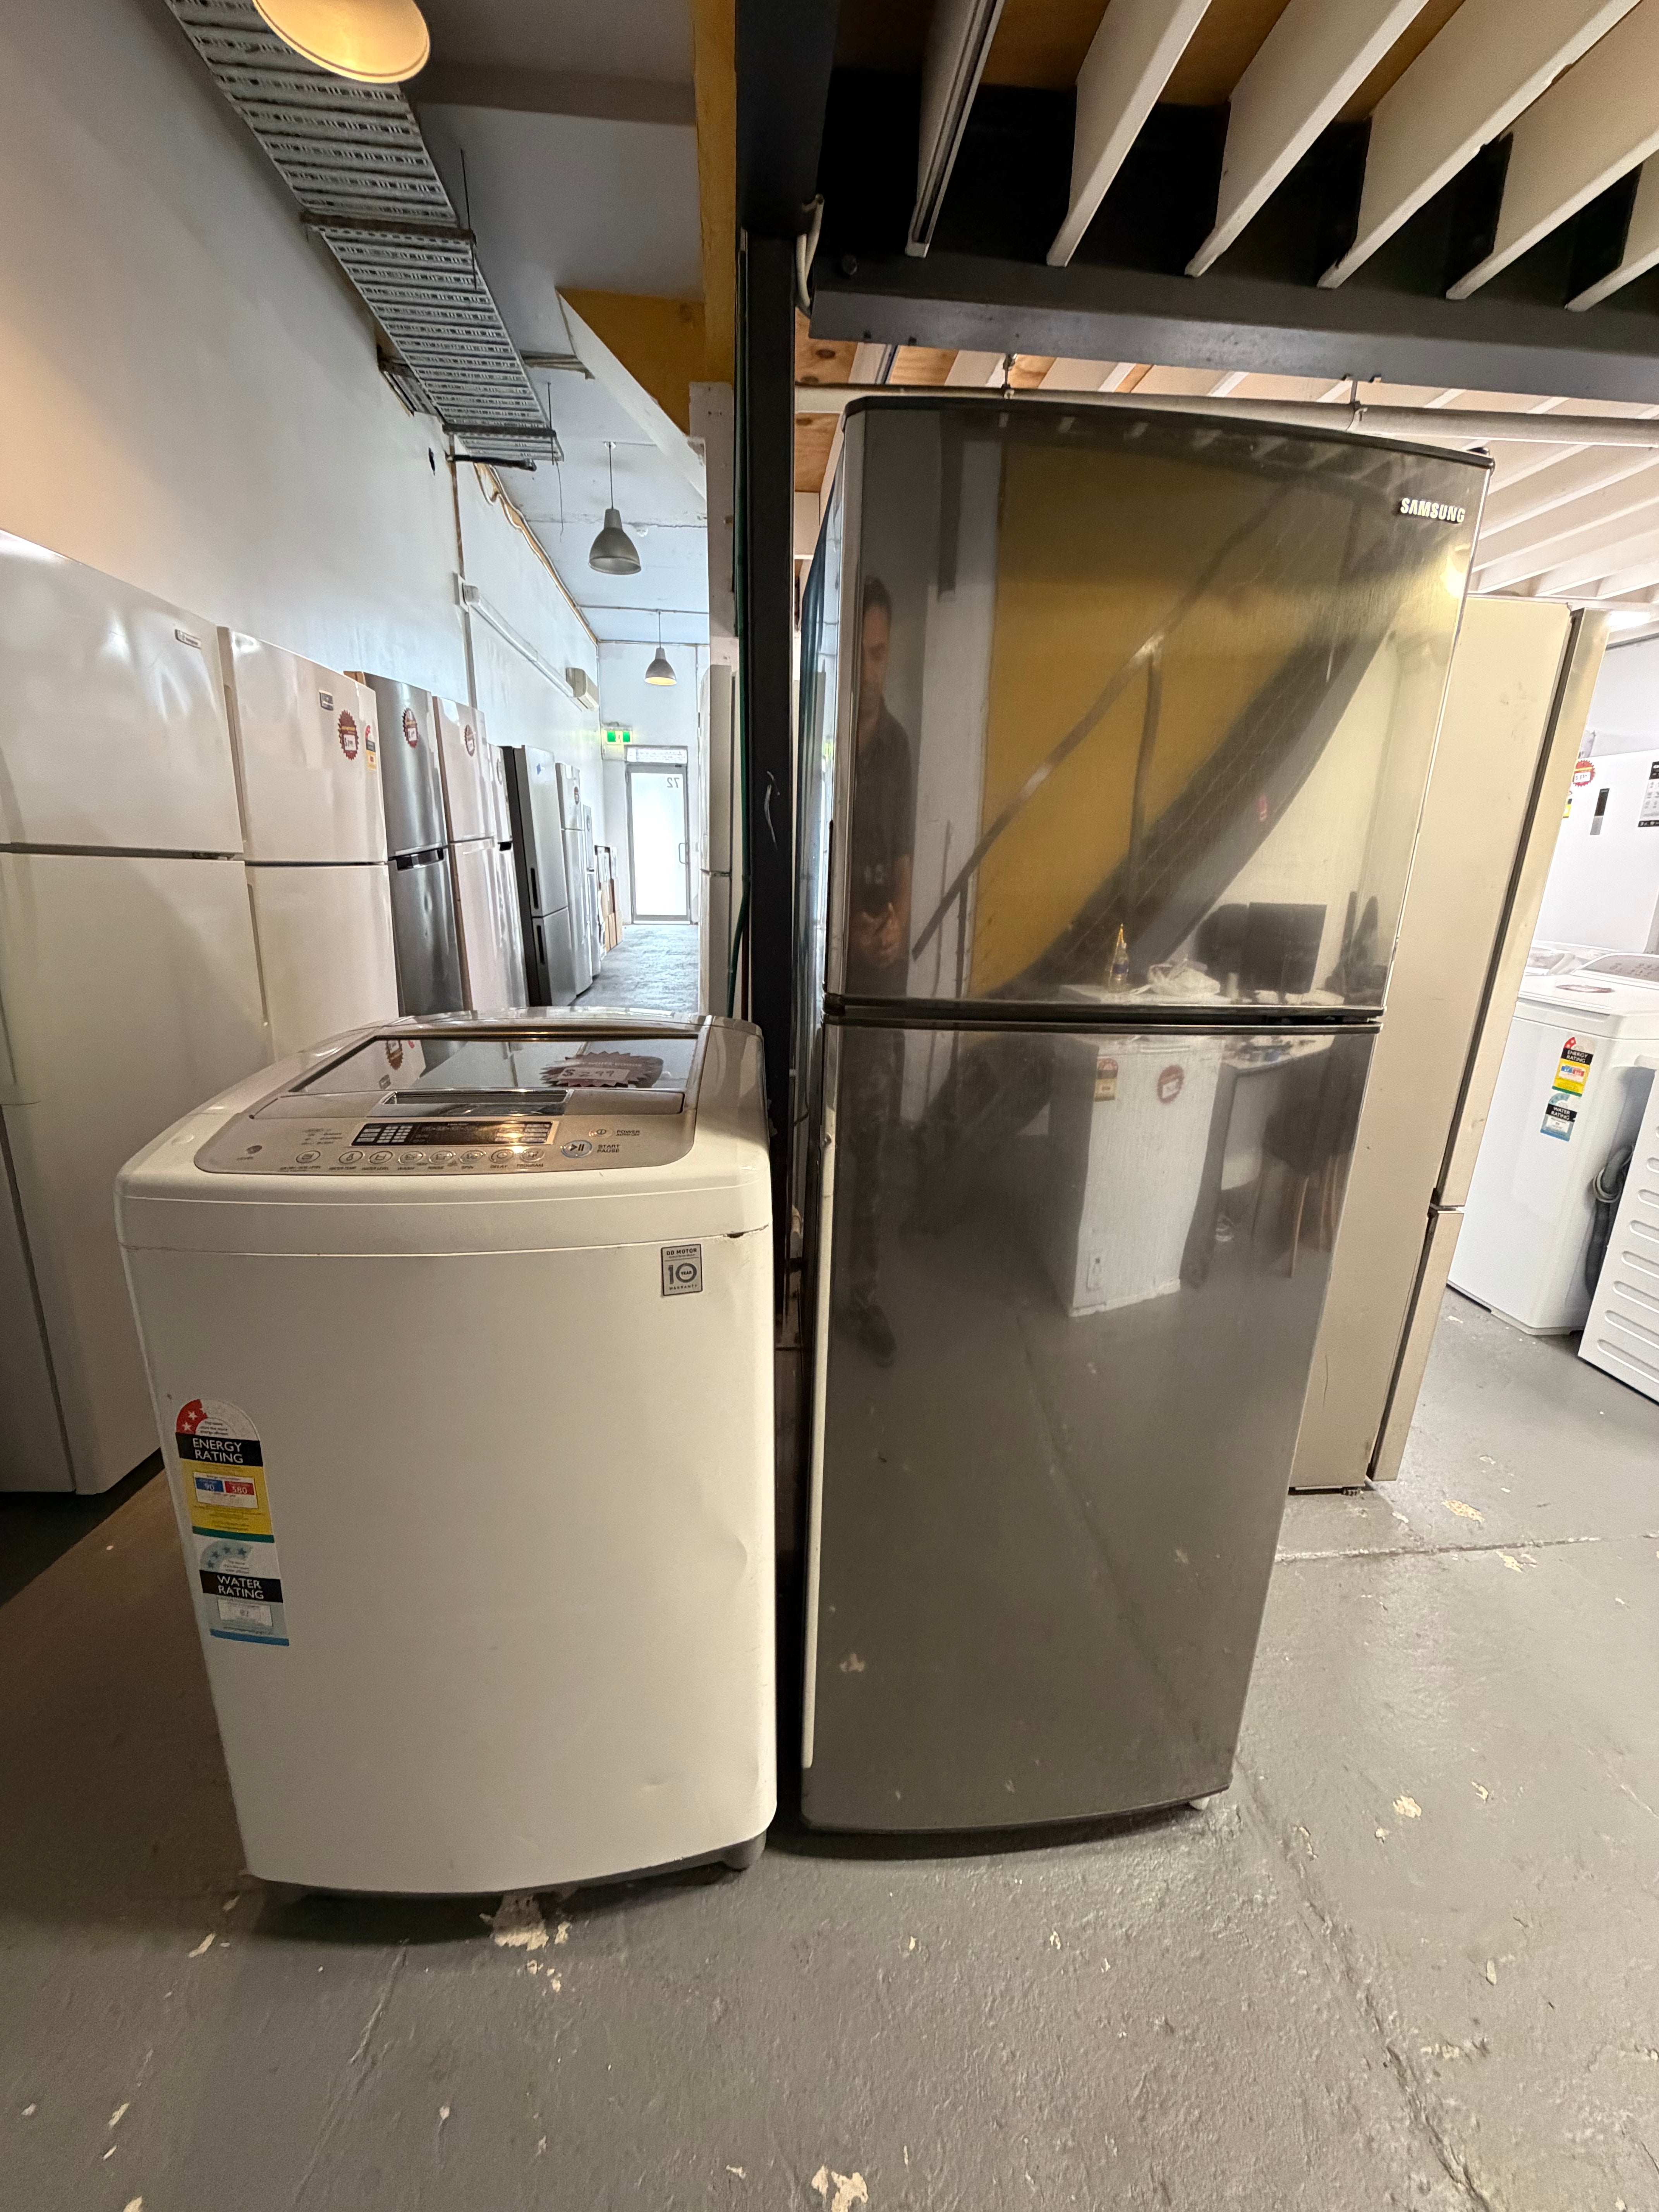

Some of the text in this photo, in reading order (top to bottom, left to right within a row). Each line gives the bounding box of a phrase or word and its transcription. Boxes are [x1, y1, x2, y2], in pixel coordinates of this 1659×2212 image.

[1400, 498, 1465, 523] SAMSUNG
[1566, 1055, 1585, 1063] RATING
[1567, 1050, 1588, 1058] ENERGY
[1551, 1111, 1570, 1120] RATING
[1553, 1107, 1570, 1115] WATER
[668, 1263, 697, 1284] 10
[192, 1438, 242, 1452] ENERGY
[195, 1449, 243, 1463] RATING
[217, 1575, 262, 1589] WATER
[218, 1585, 264, 1599] RATING
